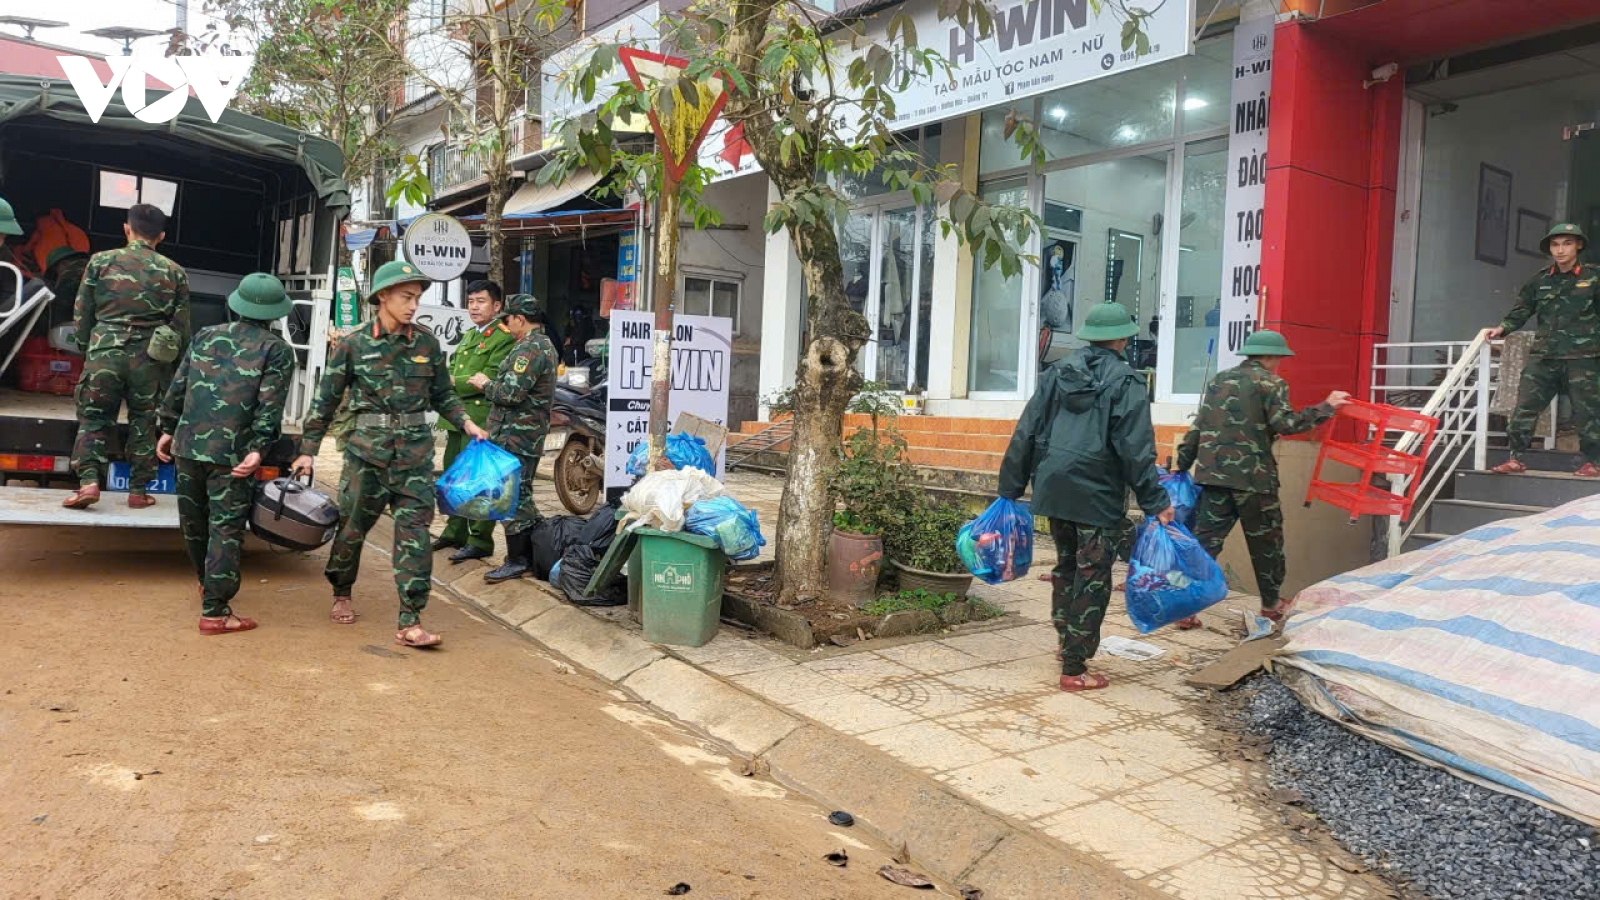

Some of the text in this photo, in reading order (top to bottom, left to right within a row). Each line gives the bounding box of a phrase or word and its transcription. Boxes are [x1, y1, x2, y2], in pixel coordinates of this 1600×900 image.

[934, 79, 958, 97] TẠO
[963, 67, 991, 89] MẪU
[995, 59, 1024, 78] TÓC
[1029, 48, 1063, 69] NAM
[1082, 34, 1105, 54] NỮ
[1235, 59, 1271, 79] H-WI
[1235, 91, 1271, 137] NHẬ
[1237, 208, 1265, 248] TẠO
[414, 244, 466, 259] H-WIN
[621, 321, 651, 340] HAIR
[1228, 314, 1257, 352] VIÊ
